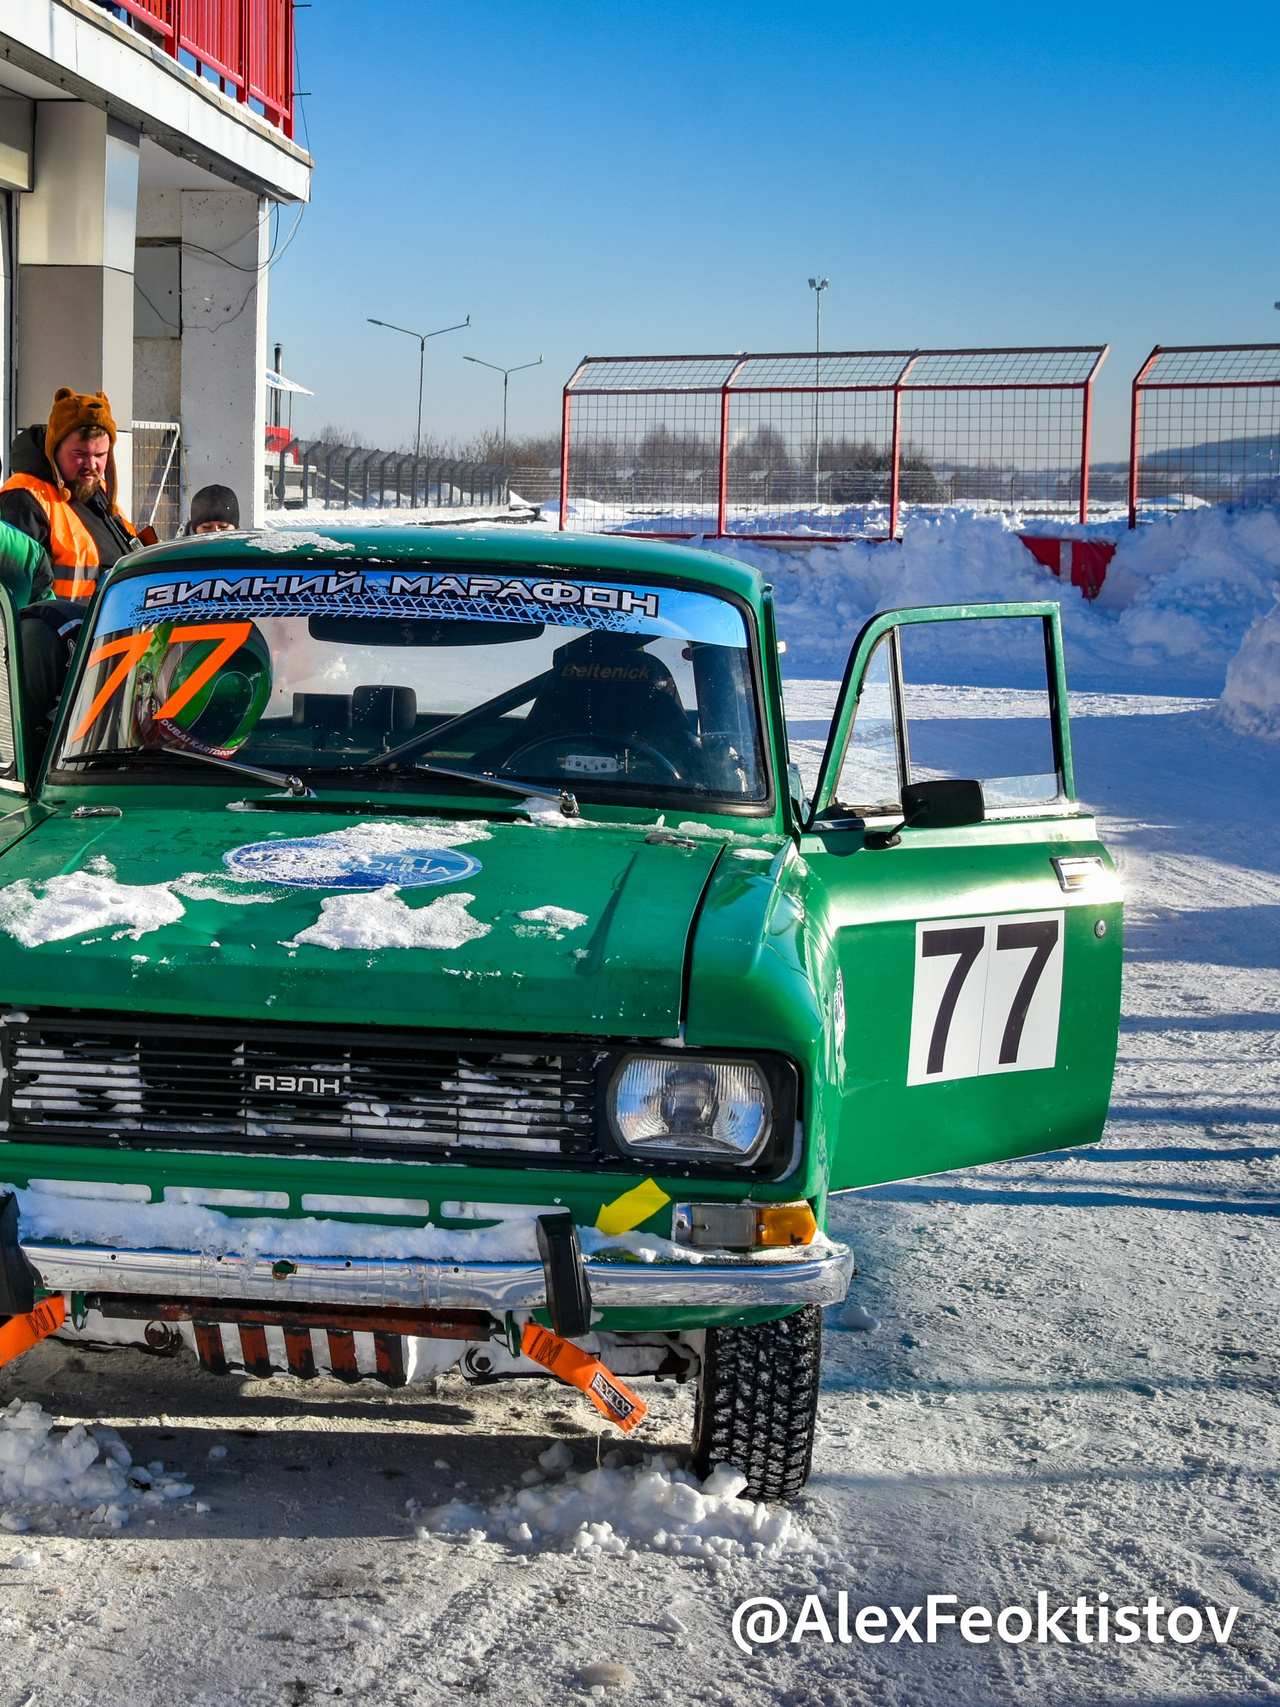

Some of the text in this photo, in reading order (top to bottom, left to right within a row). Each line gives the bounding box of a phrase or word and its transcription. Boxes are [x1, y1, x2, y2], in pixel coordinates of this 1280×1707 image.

[143, 571, 659, 618] ЗИМНИЙ МАРАФОН
[71, 622, 253, 744] 77
[561, 662, 651, 680] Beltenick
[160, 718, 191, 742] DUBAI
[921, 920, 1059, 1075] 77
[591, 1371, 632, 1416] sparco
